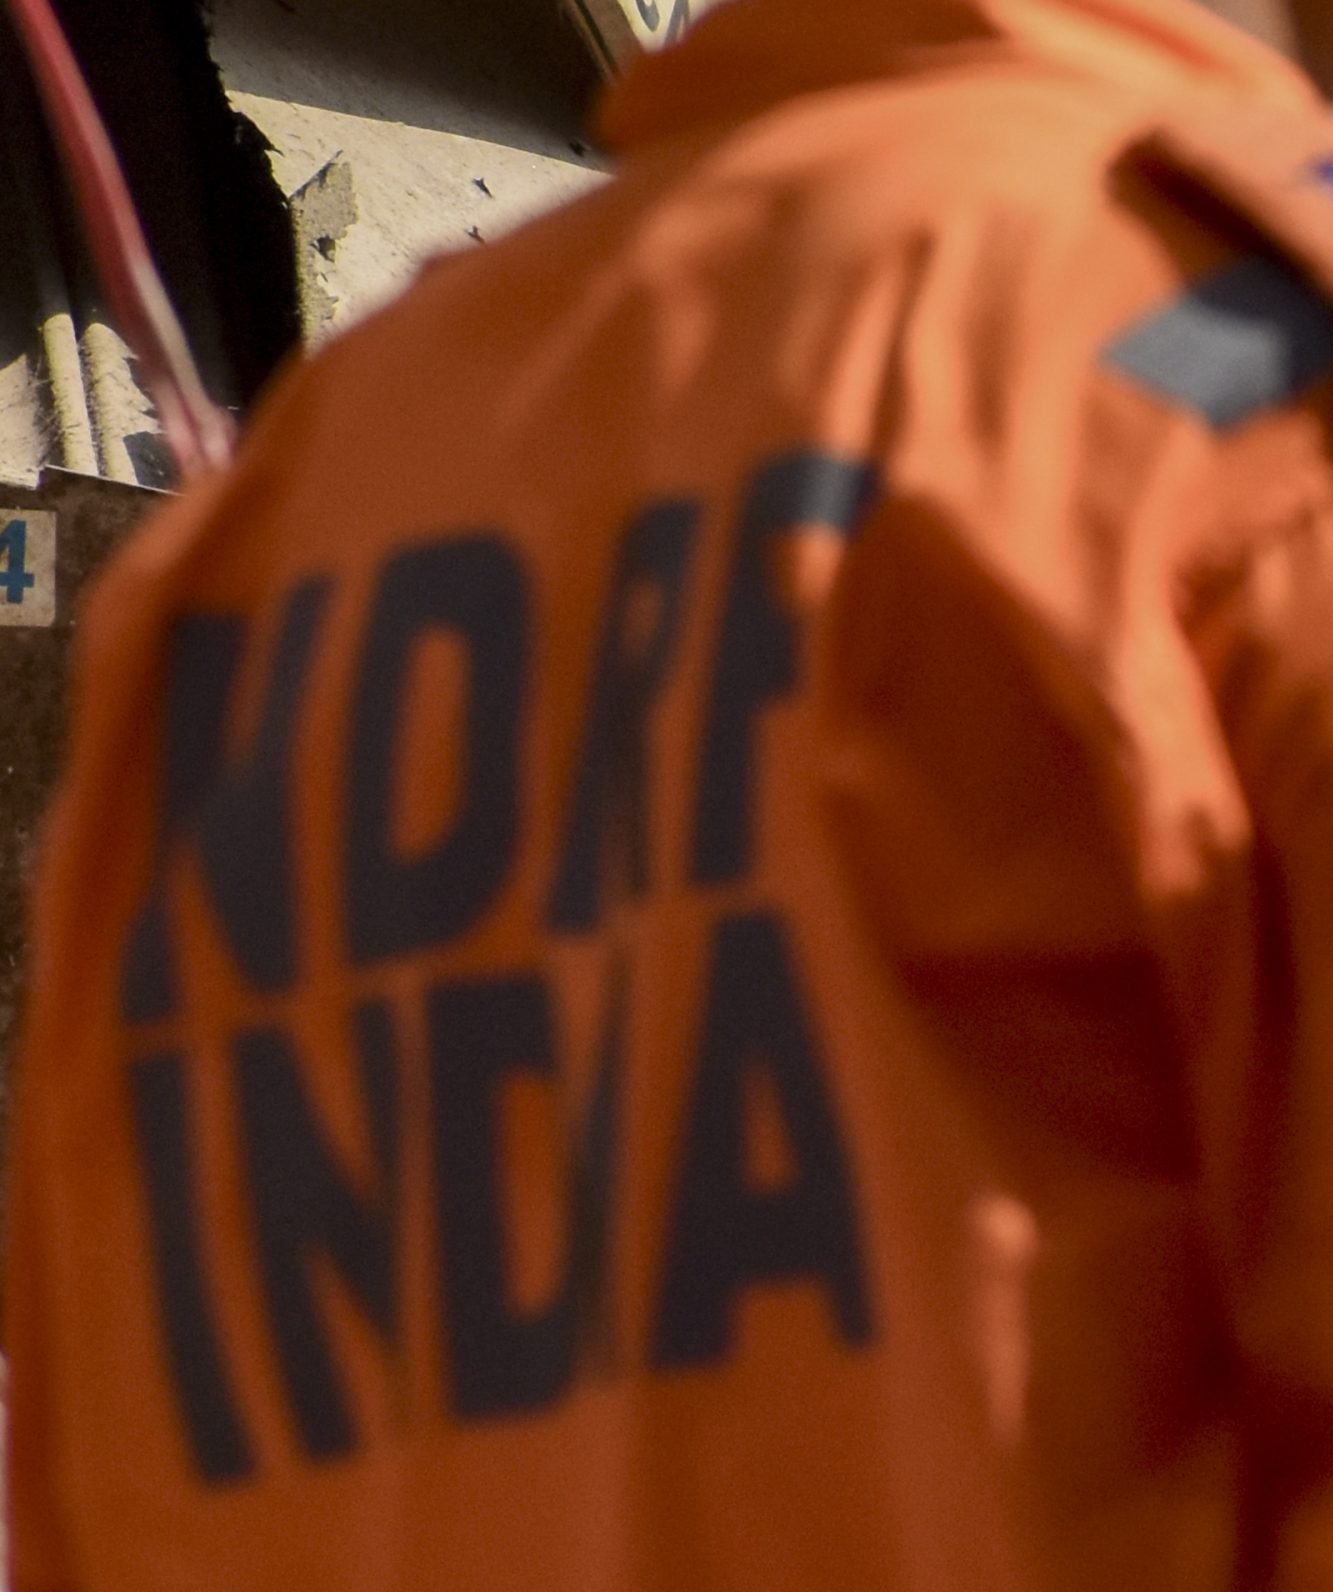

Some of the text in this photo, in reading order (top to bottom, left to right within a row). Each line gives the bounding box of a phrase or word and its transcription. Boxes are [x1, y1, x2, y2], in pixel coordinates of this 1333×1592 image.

[0, 519, 35, 604] 4
[120, 446, 880, 1024] NDRF
[124, 906, 880, 1488] INDIA
